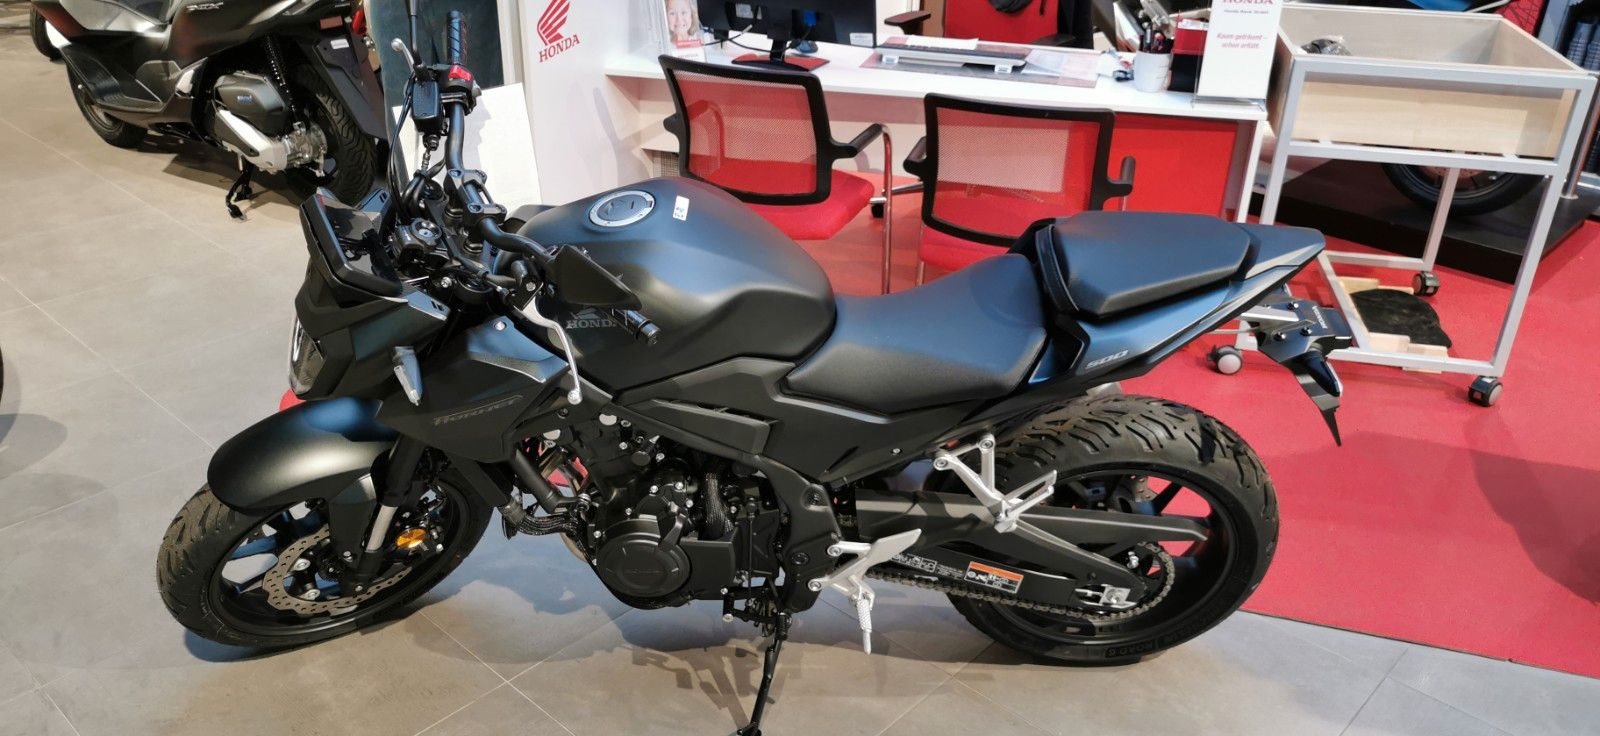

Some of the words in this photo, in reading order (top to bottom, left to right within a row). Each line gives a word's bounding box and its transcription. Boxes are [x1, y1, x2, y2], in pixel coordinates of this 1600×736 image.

[539, 34, 580, 63] HONDA
[566, 319, 617, 329] HOND
[1086, 350, 1129, 369] 500
